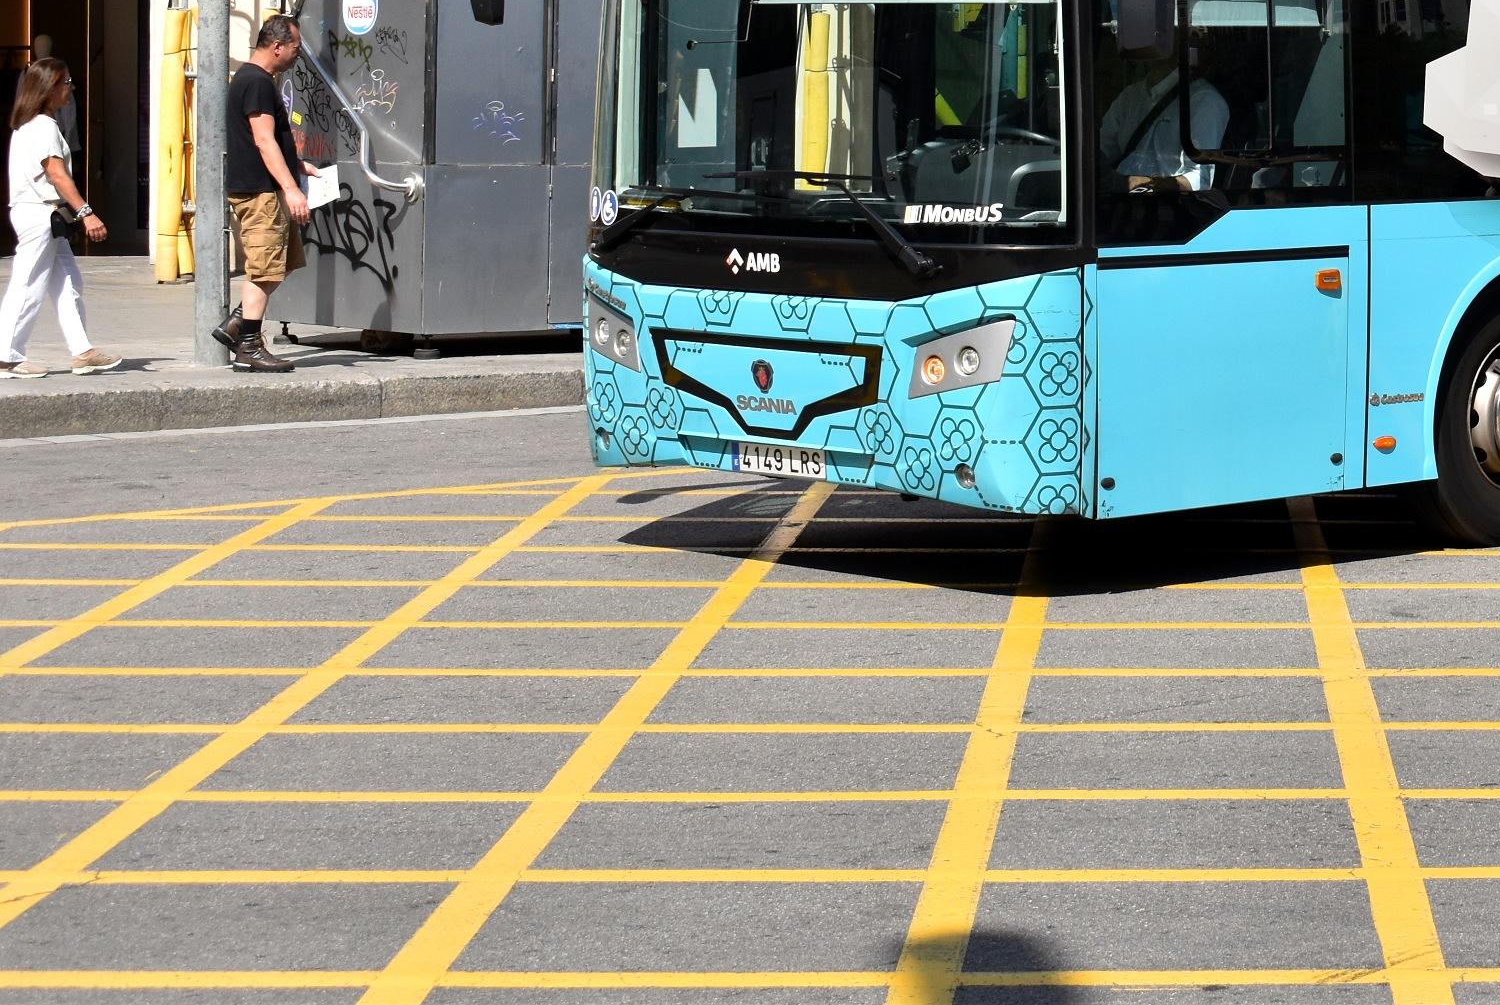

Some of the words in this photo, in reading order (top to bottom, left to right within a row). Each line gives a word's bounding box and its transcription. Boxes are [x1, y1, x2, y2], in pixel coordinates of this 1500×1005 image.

[746, 252, 781, 274] AMB
[736, 395, 797, 415] SCANIA
[743, 445, 783, 471] 4149
[789, 449, 820, 474] LRS
